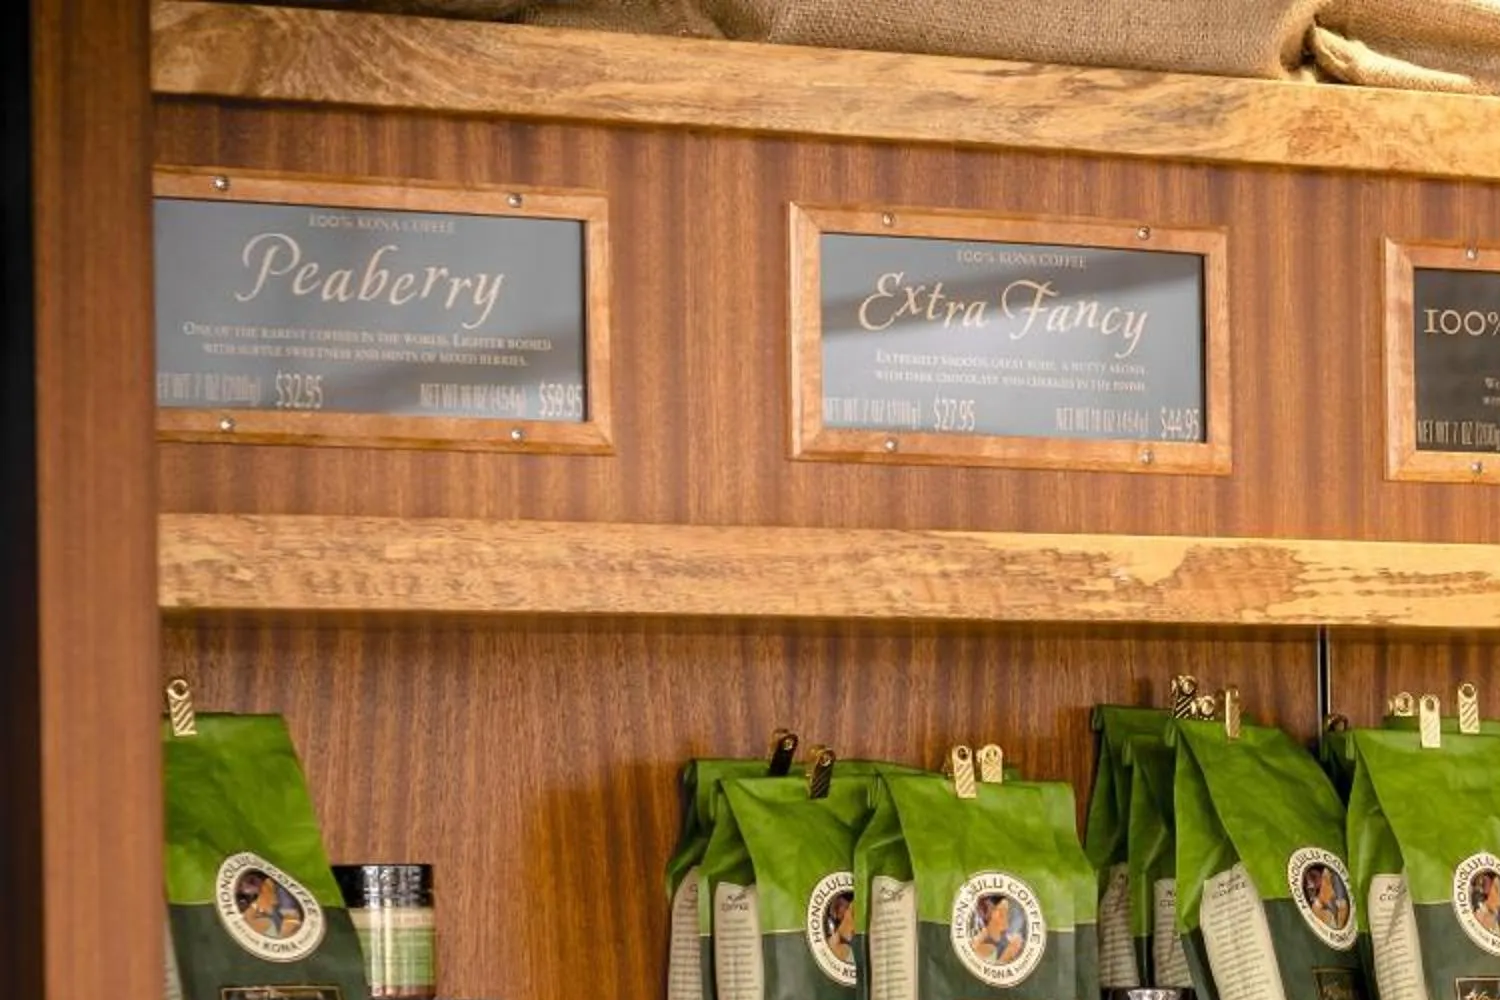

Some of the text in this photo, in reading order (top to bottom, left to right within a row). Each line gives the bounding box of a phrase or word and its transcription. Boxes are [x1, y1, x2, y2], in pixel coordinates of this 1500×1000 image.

[234, 232, 505, 330] Peaberry
[858, 272, 1149, 358] Extra Fancy
[932, 391, 976, 432] $27.95
[1418, 419, 1433, 444] NET
[1007, 881, 1041, 945] COFFEE
